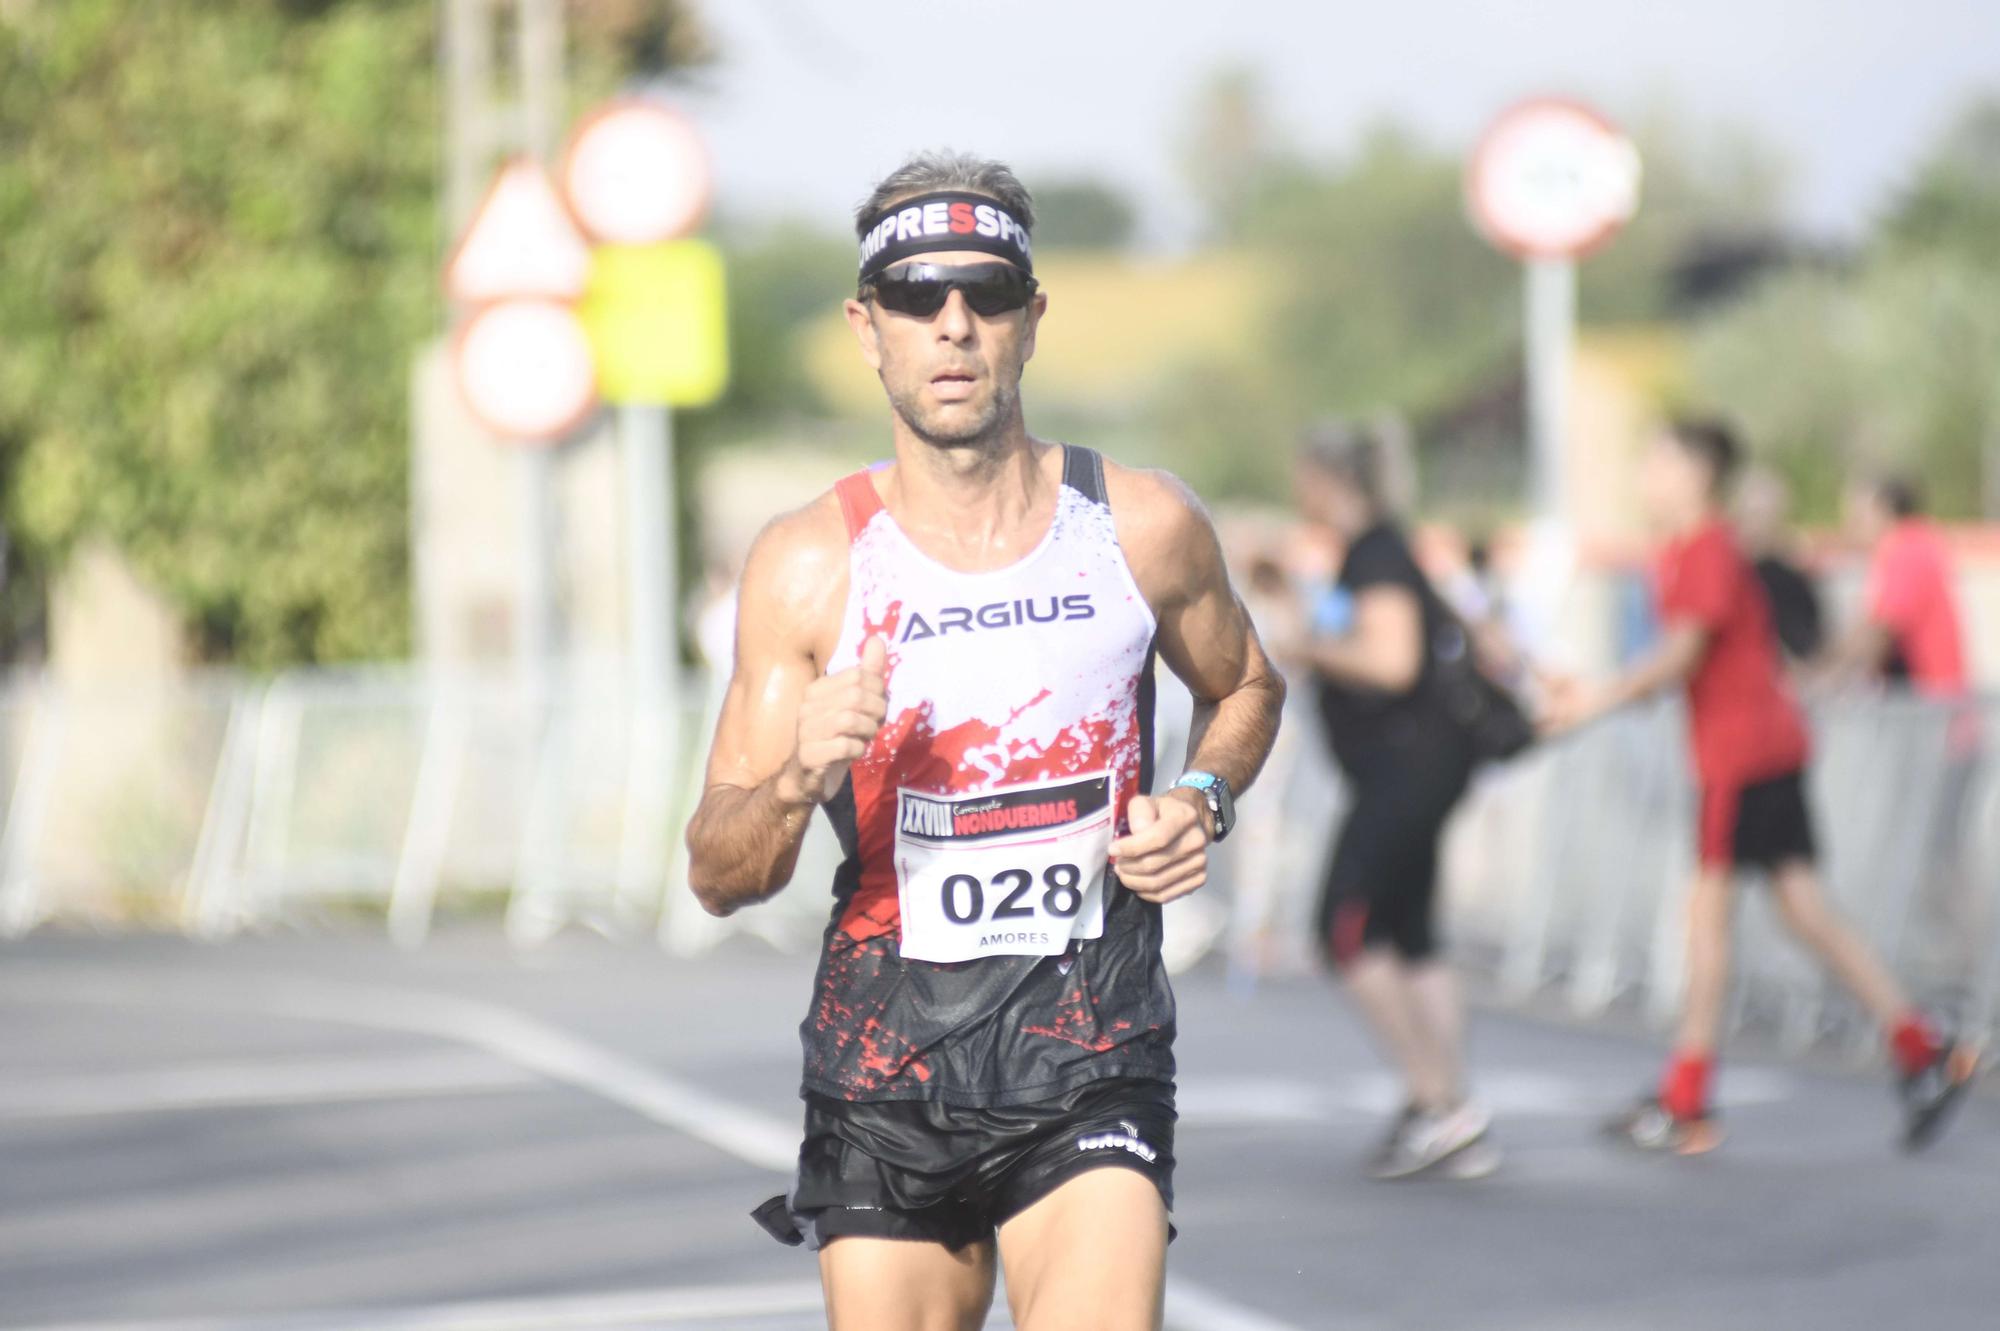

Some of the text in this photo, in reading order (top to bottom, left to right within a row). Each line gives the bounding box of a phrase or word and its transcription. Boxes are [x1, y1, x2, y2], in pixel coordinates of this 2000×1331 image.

[901, 594, 1095, 643] ARGIUS
[902, 797, 953, 837] XXVIII
[954, 800, 1077, 837] NONDUERMAS
[941, 863, 1082, 925] 028
[980, 932, 1049, 948] AMORES
